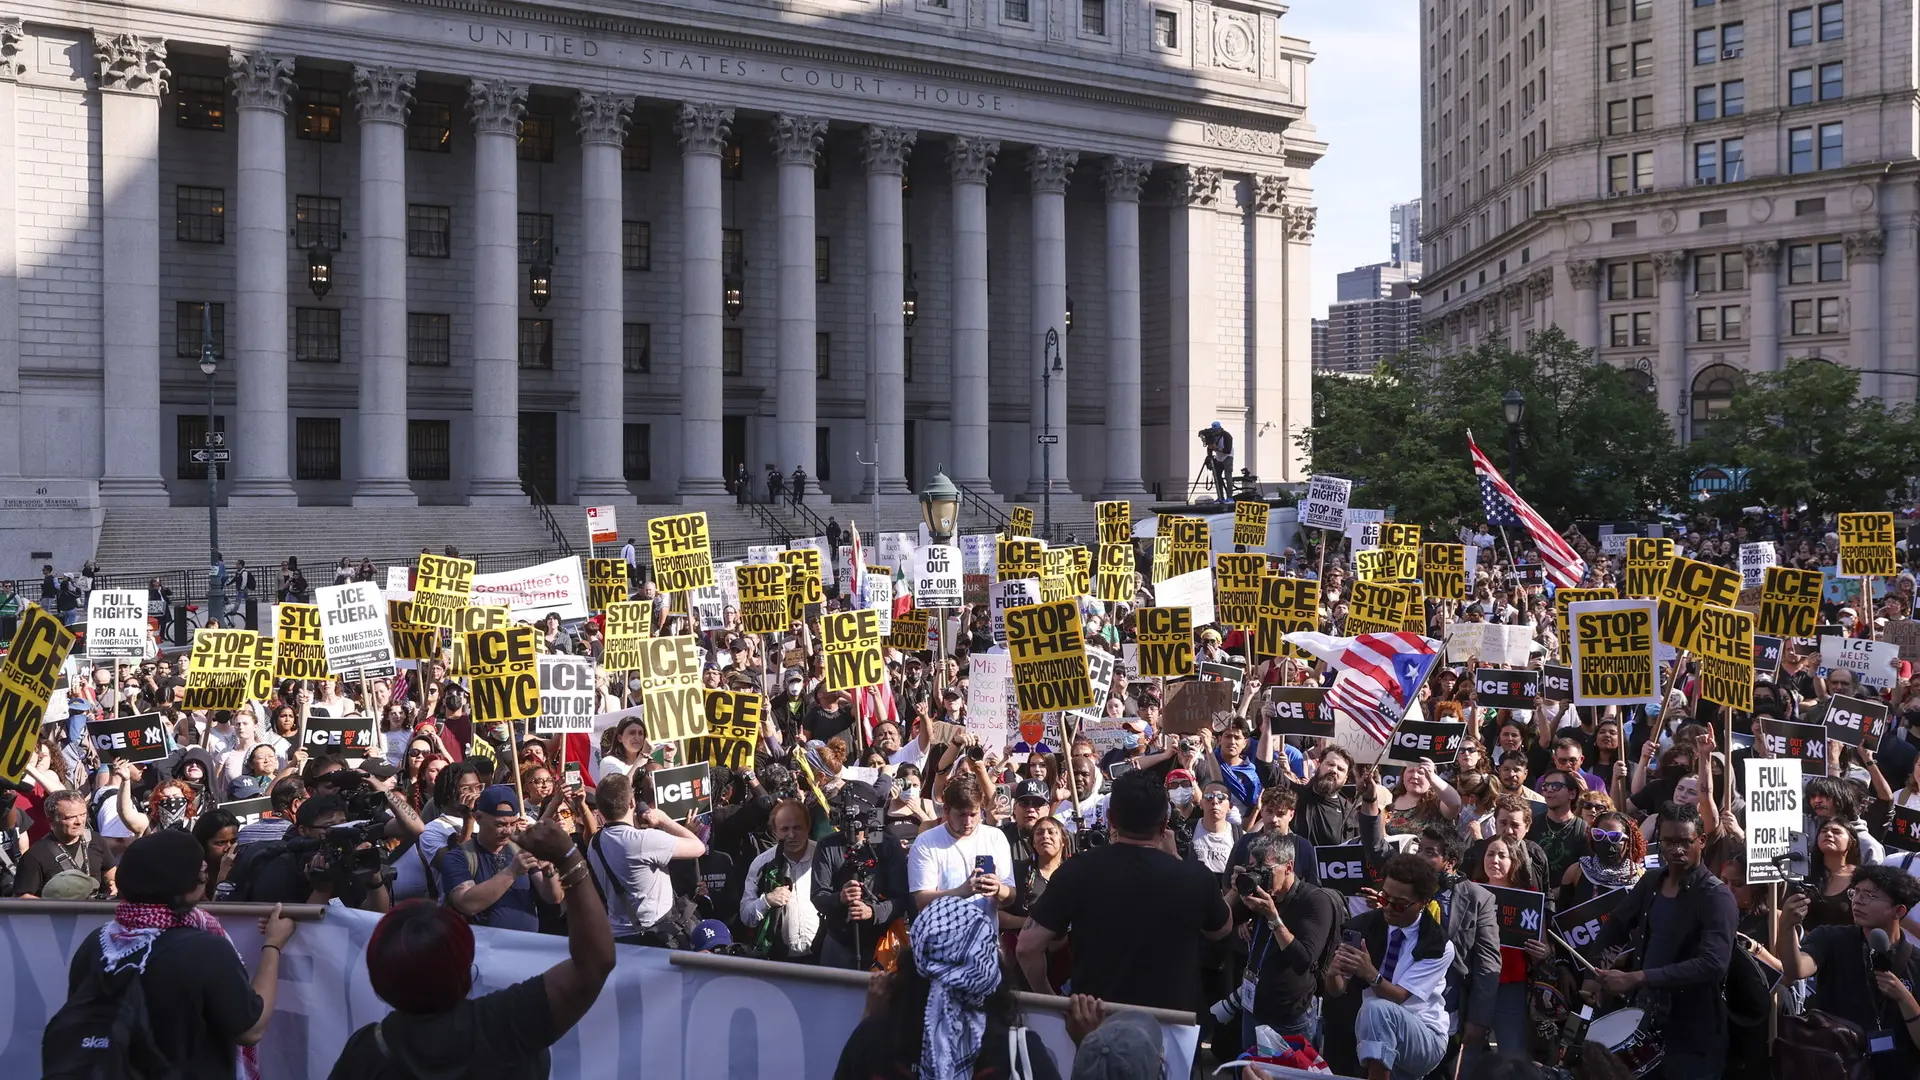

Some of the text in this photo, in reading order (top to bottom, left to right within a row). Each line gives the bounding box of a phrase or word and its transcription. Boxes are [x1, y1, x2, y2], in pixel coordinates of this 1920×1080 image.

[468, 24, 1002, 112] UNITED STATES COURT HOUSE
[36, 487, 47, 495] 40
[1311, 488, 1347, 504] RIGHTS!
[1012, 507, 1032, 522] ICE
[1100, 502, 1129, 519] ICE
[1237, 503, 1268, 516] STOP
[1309, 502, 1329, 515] STOP
[1331, 507, 1344, 518] THE
[651, 516, 705, 541] STOP
[1236, 515, 1266, 524] THE
[1840, 515, 1891, 531] STOP
[1100, 522, 1129, 543] NYC
[1174, 522, 1208, 543] ICE
[1233, 533, 1265, 545] NOW!
[1235, 525, 1266, 534] DEPORTATIONS
[1363, 525, 1378, 535] ICE
[1380, 526, 1418, 546] ICE
[1841, 532, 1891, 542] THE
[652, 535, 707, 554] THE
[1361, 536, 1379, 545] OUT
[1629, 539, 1672, 560] ICE
[928, 548, 947, 560] ICE
[999, 542, 1041, 563] ICE
[1101, 544, 1133, 566] ICE
[1358, 550, 1394, 570] STOP
[1425, 543, 1463, 565] ICE
[1842, 546, 1892, 558] DEPORTATIONS
[420, 556, 472, 580] STOP
[589, 559, 625, 579] ICE
[655, 552, 709, 572] DEPORTATIONS
[926, 561, 950, 573] OUT
[1218, 555, 1264, 575] STOP
[1842, 559, 1894, 574] NOW!
[658, 569, 712, 592] NOW!
[737, 566, 784, 586] STOP
[1360, 566, 1396, 580] THE
[1668, 557, 1741, 606] ICE
[1743, 569, 1761, 578] STOP
[1768, 568, 1820, 597] ICE
[419, 575, 470, 593] THE
[475, 575, 569, 593] Committee to
[739, 585, 784, 597] THE
[921, 579, 934, 589] OF
[936, 578, 956, 589] OUR
[1099, 574, 1133, 600] NYC
[1425, 572, 1464, 599] NYC
[102, 594, 135, 606] FULL
[416, 591, 468, 609] DEPORTATIONS
[996, 597, 1034, 608] FUERA
[1262, 579, 1316, 611] ICE
[1353, 583, 1406, 609] STOP
[1662, 589, 1702, 606] OUT
[1763, 592, 1794, 601] OUT
[1798, 595, 1818, 603] OF
[93, 607, 142, 619] RIGHTS
[328, 605, 378, 626] FUERA
[608, 603, 651, 623] STOP
[741, 600, 785, 616] DEPORTATIONS
[1259, 606, 1316, 619] OUT OF
[1352, 602, 1403, 623] THE
[455, 607, 505, 633] ICE
[607, 621, 650, 635] THE
[743, 613, 787, 633] NOW!
[825, 611, 877, 644] ICE
[1007, 605, 1076, 639] STOP
[1139, 607, 1190, 634] ICE
[1579, 611, 1648, 639] STOP
[1702, 608, 1750, 641] STOP
[1760, 602, 1815, 637] NYC
[95, 628, 139, 638] FOR ALL
[196, 632, 254, 653] STOP
[329, 629, 383, 644] DE NUESTRAS
[1171, 633, 1191, 641] OF
[329, 639, 386, 655] COMUNIDADES!
[392, 631, 442, 660] NYC
[467, 630, 532, 666] ICE
[825, 639, 879, 652] OUT OF
[1009, 632, 1081, 657] THE
[1580, 635, 1649, 654] THE
[1702, 634, 1750, 660] THE
[1843, 642, 1873, 652] ICE
[194, 654, 250, 668] THE
[641, 638, 697, 678] ICE
[1140, 642, 1192, 676] NYC
[1581, 655, 1650, 674] DEPORTATIONS
[1837, 659, 1870, 670] UNDER
[1840, 652, 1870, 661] MELTS
[469, 662, 535, 676] OUT OF
[540, 663, 593, 690] ICE
[828, 648, 881, 690] NYC
[1014, 656, 1084, 685] DEPORTATIONS
[1703, 657, 1750, 686] DEPORTATIONS
[2, 662, 50, 701] FUERA DE
[189, 671, 248, 688] DEPORTATIONS
[642, 674, 699, 688] OUT OF
[1477, 679, 1508, 695] ICE
[1546, 675, 1569, 691] ICE
[1582, 672, 1651, 696] NOW!
[184, 688, 246, 708] NOW!
[471, 674, 539, 720] NYC
[1017, 677, 1091, 712] NOW!
[1703, 674, 1751, 711] NOW!
[541, 696, 592, 715] OUT OF
[645, 689, 704, 741] NYC
[539, 716, 592, 729] NEW YORK
[1827, 707, 1862, 730] ICE
[92, 730, 141, 750] ICE OUT
[305, 729, 356, 745] ICE OUT
[733, 726, 756, 737] OF
[1393, 732, 1432, 750] ICE
[1789, 738, 1803, 747] OUT
[1758, 767, 1788, 788] FULL
[657, 781, 693, 804] ICE
[1751, 789, 1797, 812] RIGHTS
[1754, 828, 1776, 844] FOR
[1319, 861, 1364, 880] ICE
[1502, 906, 1517, 916] OUT
[703, 927, 716, 938] LA
